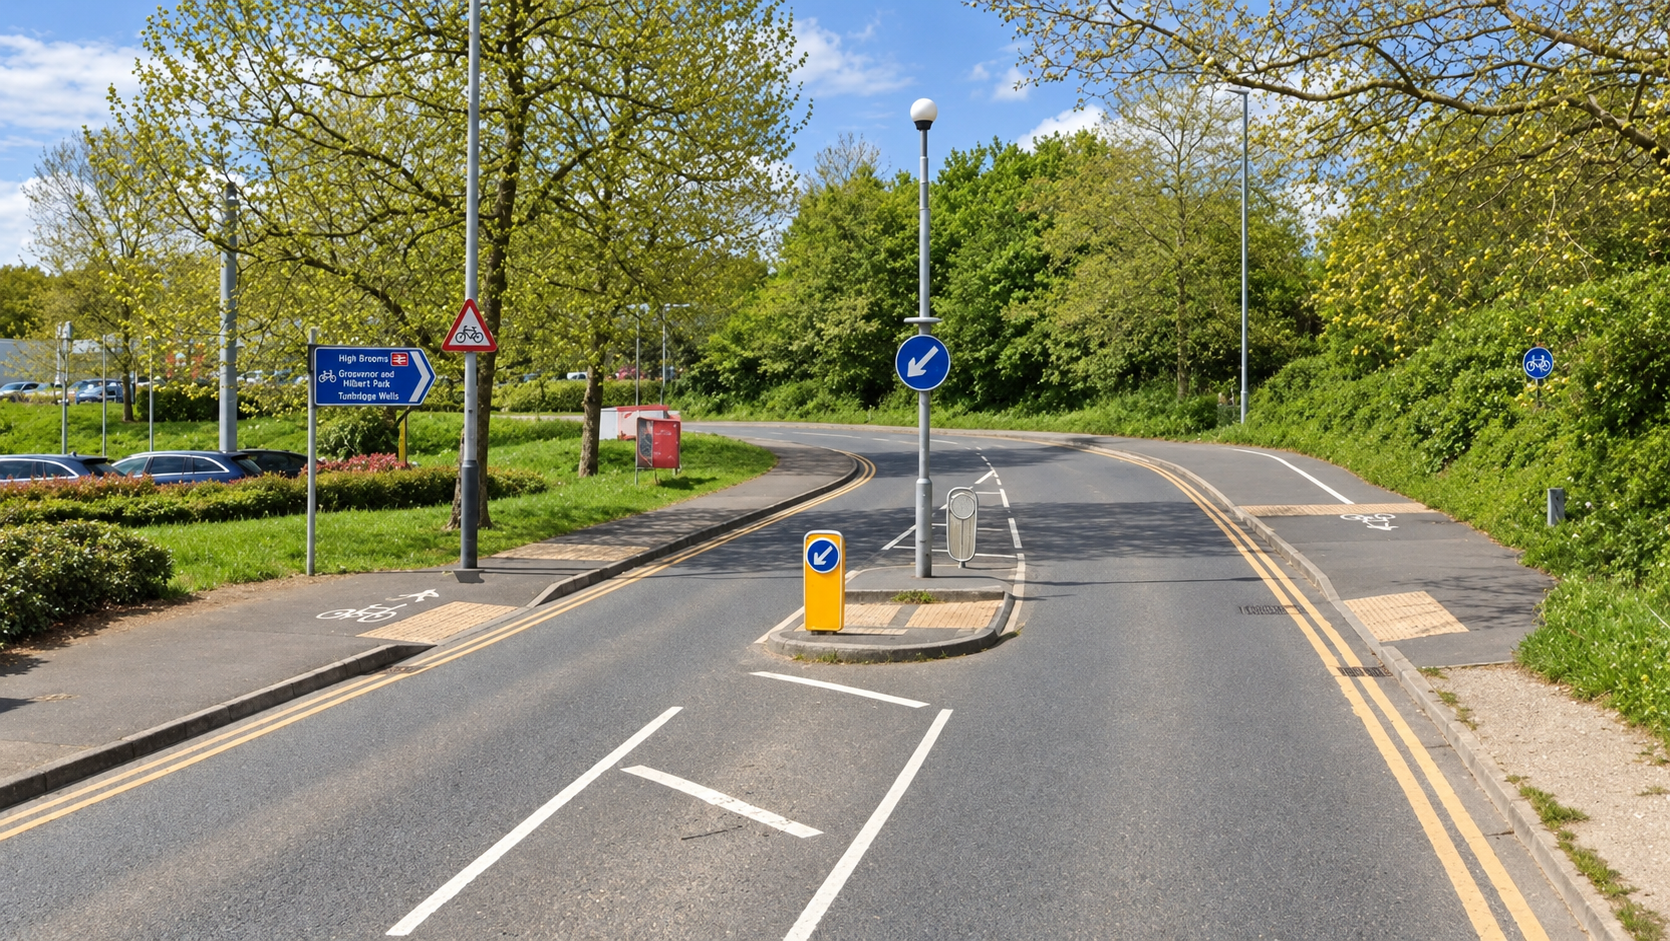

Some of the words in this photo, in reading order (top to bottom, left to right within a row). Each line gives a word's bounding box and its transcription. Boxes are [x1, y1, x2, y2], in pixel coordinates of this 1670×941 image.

[339, 354, 356, 364] High
[359, 354, 388, 363] Brooms
[373, 379, 391, 388] Park
[338, 391, 376, 401] Tunbridge
[379, 391, 399, 400] Wells
